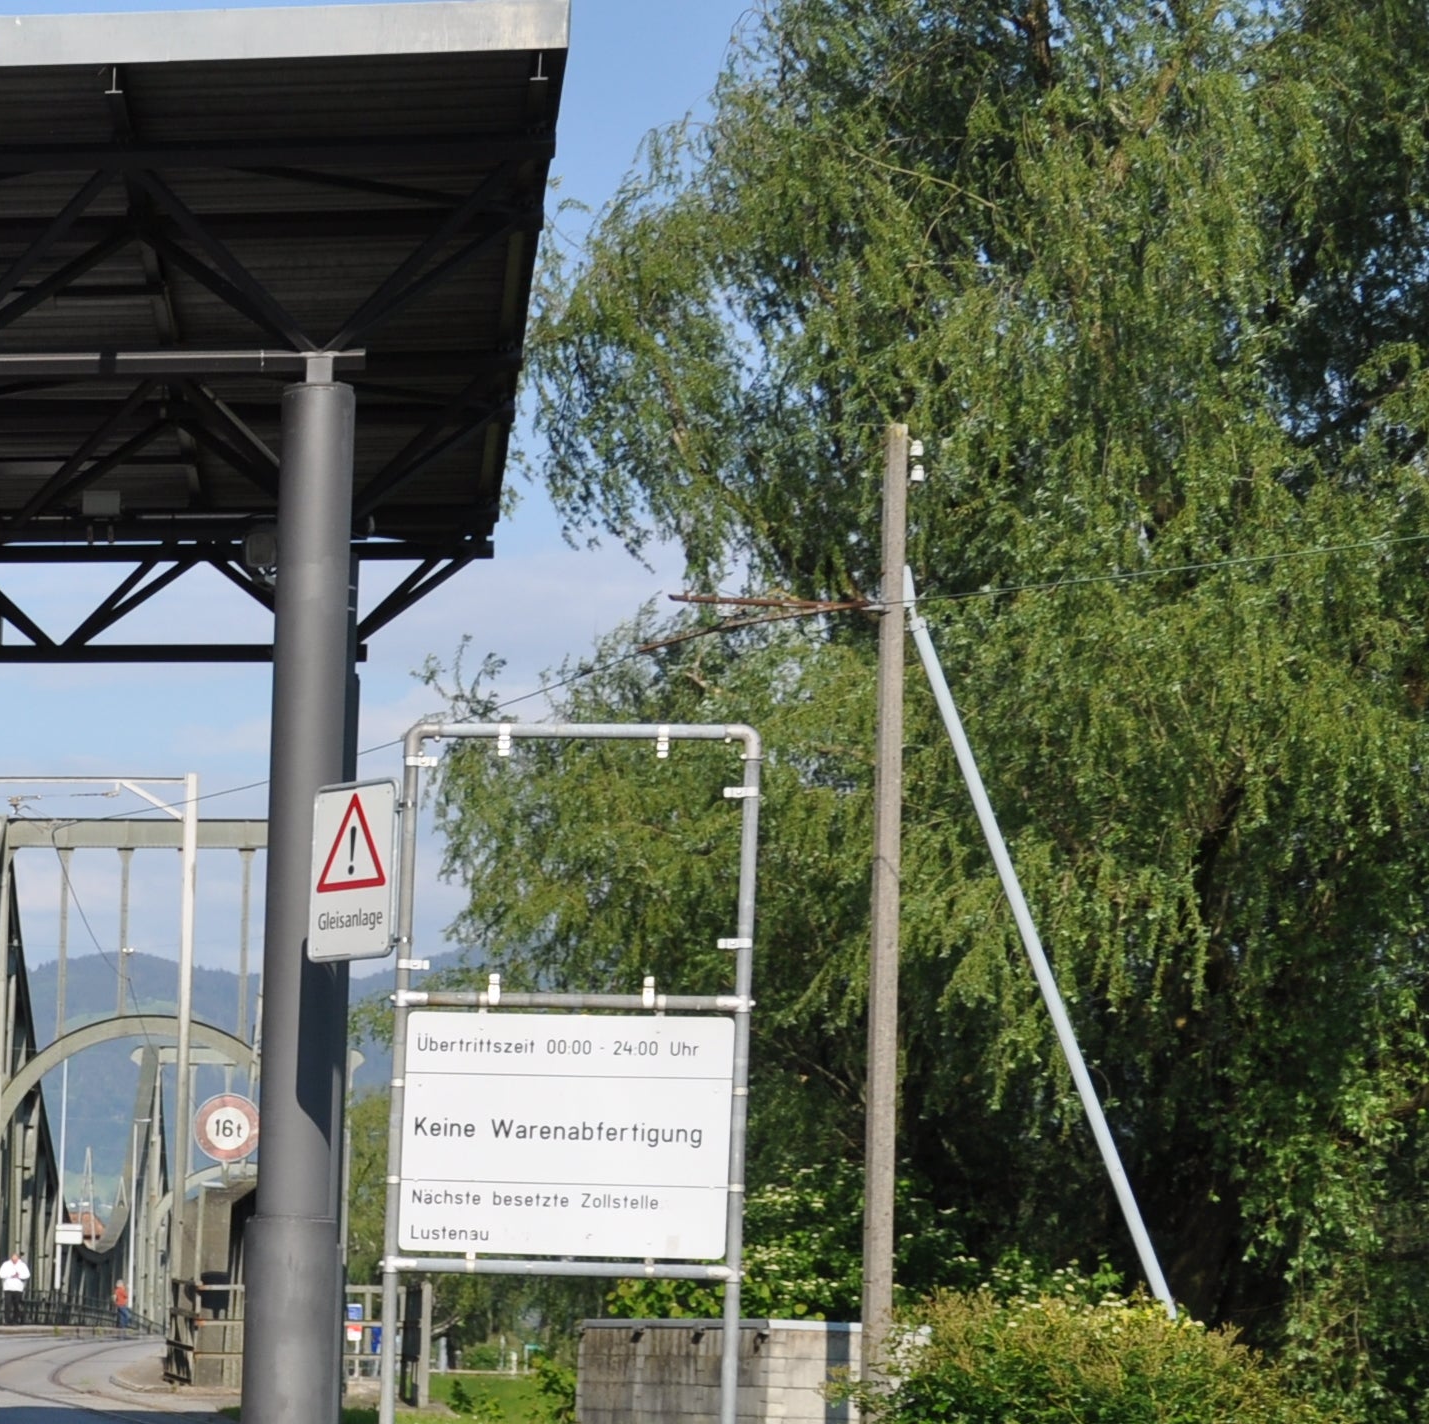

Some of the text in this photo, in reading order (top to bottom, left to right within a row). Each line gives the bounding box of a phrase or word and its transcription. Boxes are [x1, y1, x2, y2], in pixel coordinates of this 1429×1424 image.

[318, 908, 383, 931] Gleisanlage
[417, 1032, 536, 1055] Übertrittszeit
[546, 1039, 592, 1056] 00:00
[612, 1040, 659, 1057] 24:00
[670, 1041, 700, 1057] Uhr
[215, 1118, 234, 1138] 16
[413, 1116, 704, 1149] Keine Warenabfertigung
[411, 1188, 659, 1210] Nächste besetzte Zollstelle
[410, 1224, 489, 1241] Lustenau
